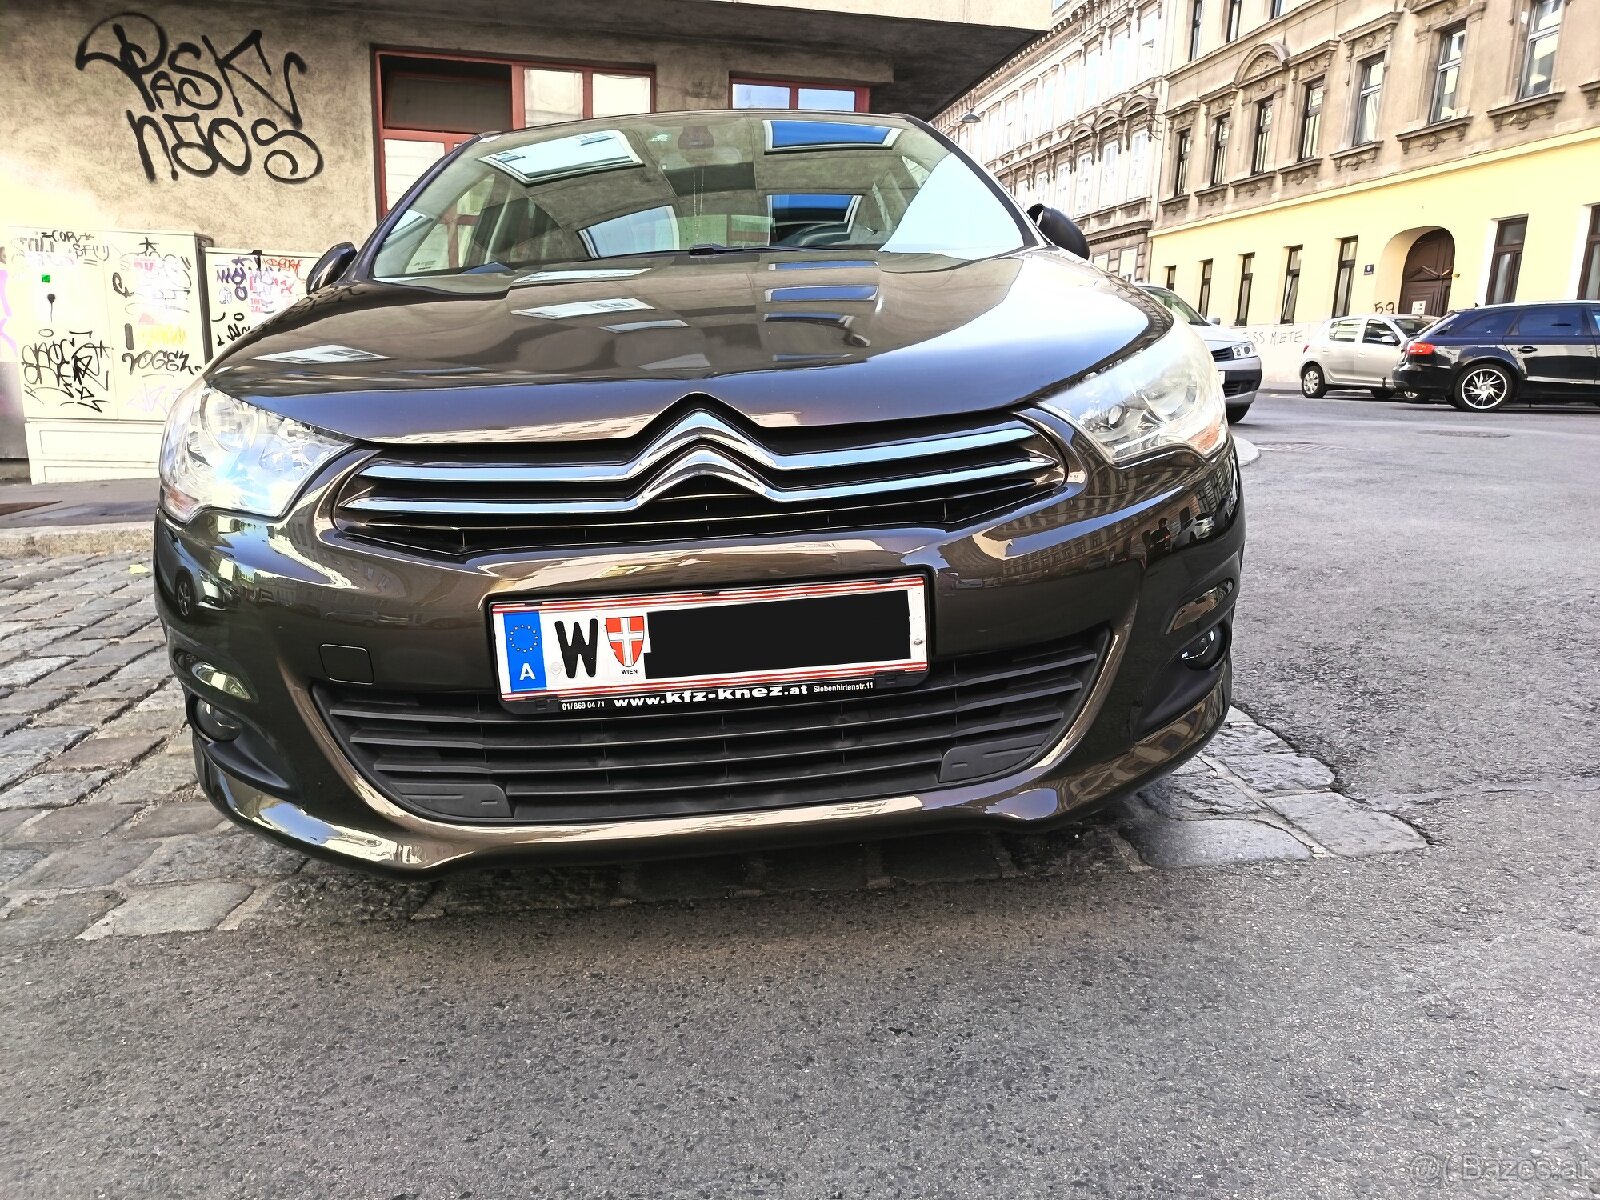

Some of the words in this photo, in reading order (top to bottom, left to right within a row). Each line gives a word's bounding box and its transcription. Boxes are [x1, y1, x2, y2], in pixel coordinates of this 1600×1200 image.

[554, 618, 599, 679] W
[519, 662, 536, 681] A
[613, 684, 808, 708] www.kfz-knez.at
